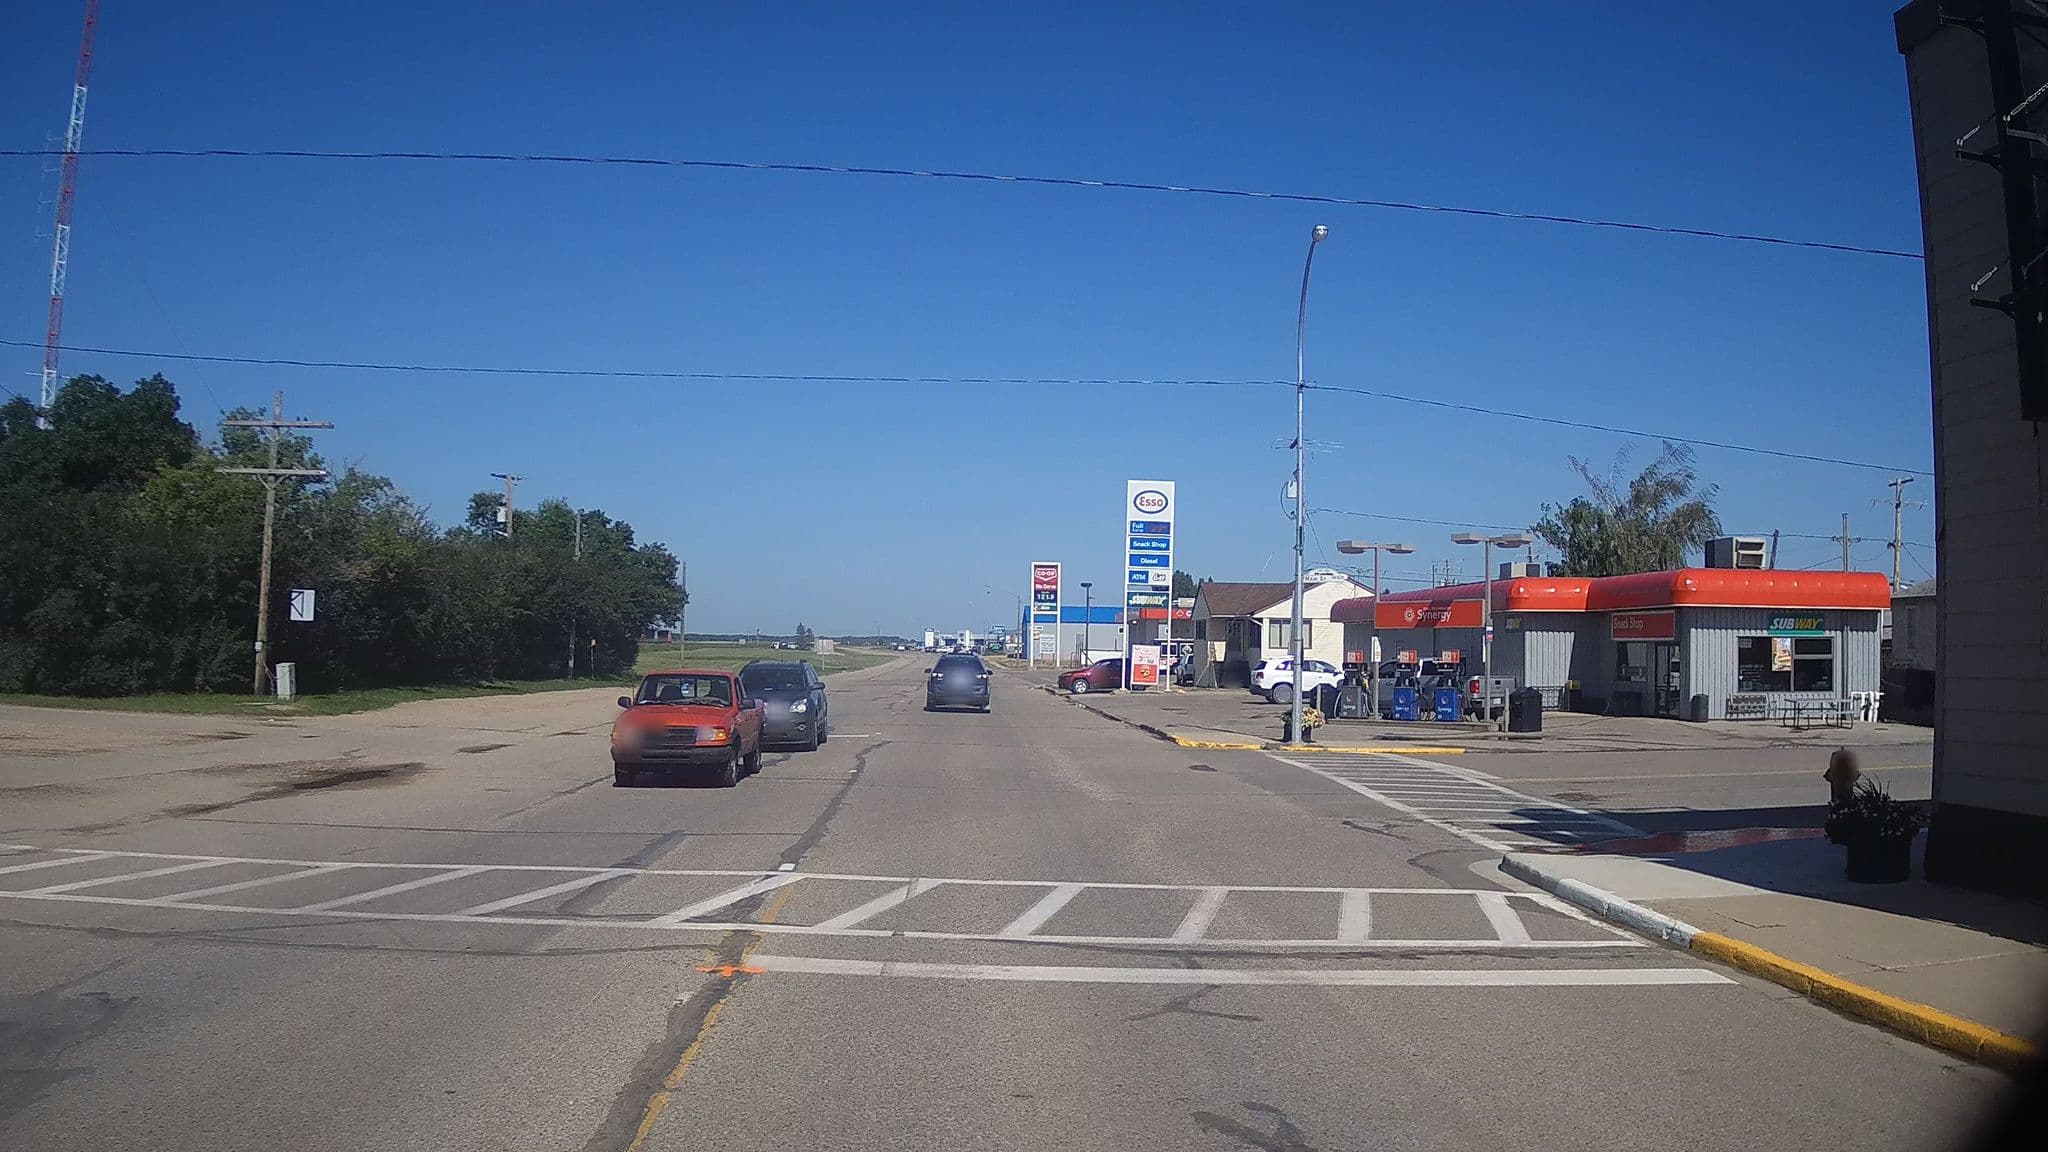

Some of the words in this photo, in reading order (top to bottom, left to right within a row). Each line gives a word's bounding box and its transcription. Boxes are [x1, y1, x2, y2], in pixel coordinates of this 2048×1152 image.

[1139, 496, 1164, 508] Esso
[1151, 541, 1167, 549] Shop
[1417, 609, 1452, 622] Synergy
[1613, 617, 1629, 629] Snack
[1629, 617, 1644, 631] Shop
[1769, 617, 1822, 630] SUBWAY
